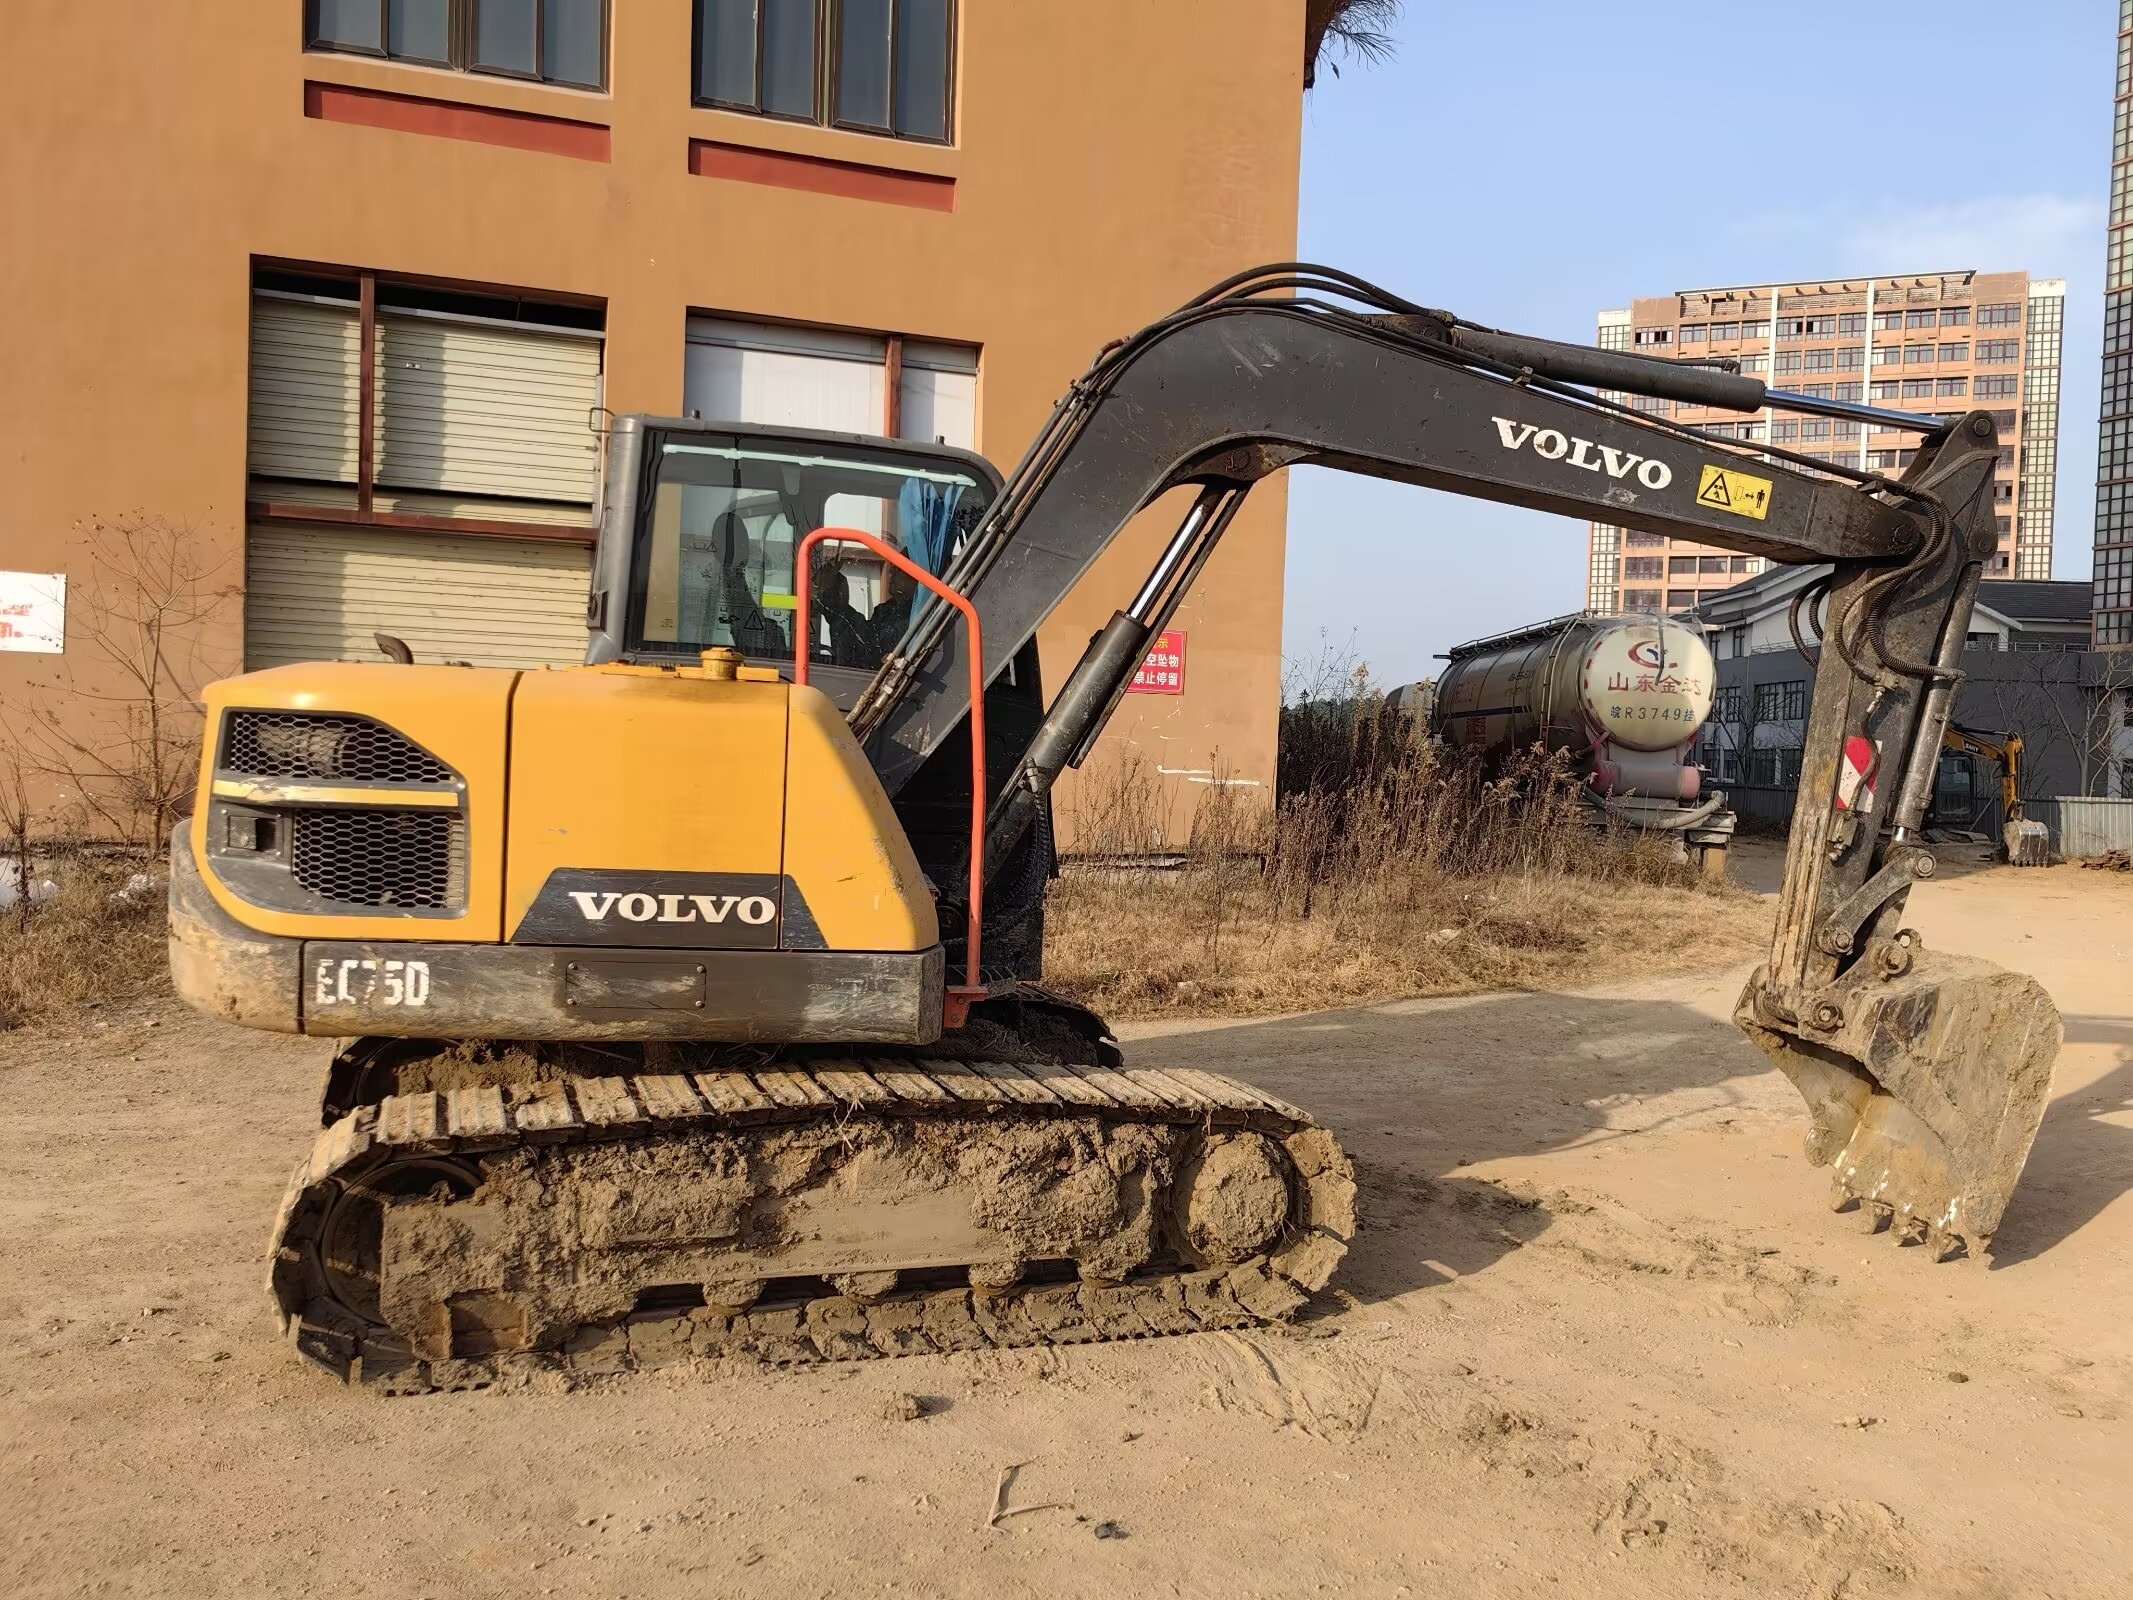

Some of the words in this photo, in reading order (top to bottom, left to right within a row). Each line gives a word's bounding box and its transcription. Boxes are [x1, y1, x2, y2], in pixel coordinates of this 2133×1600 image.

[1491, 416, 1672, 490] VOLVO
[568, 891, 776, 925] VOLVO
[316, 958, 430, 1006] EC75D
